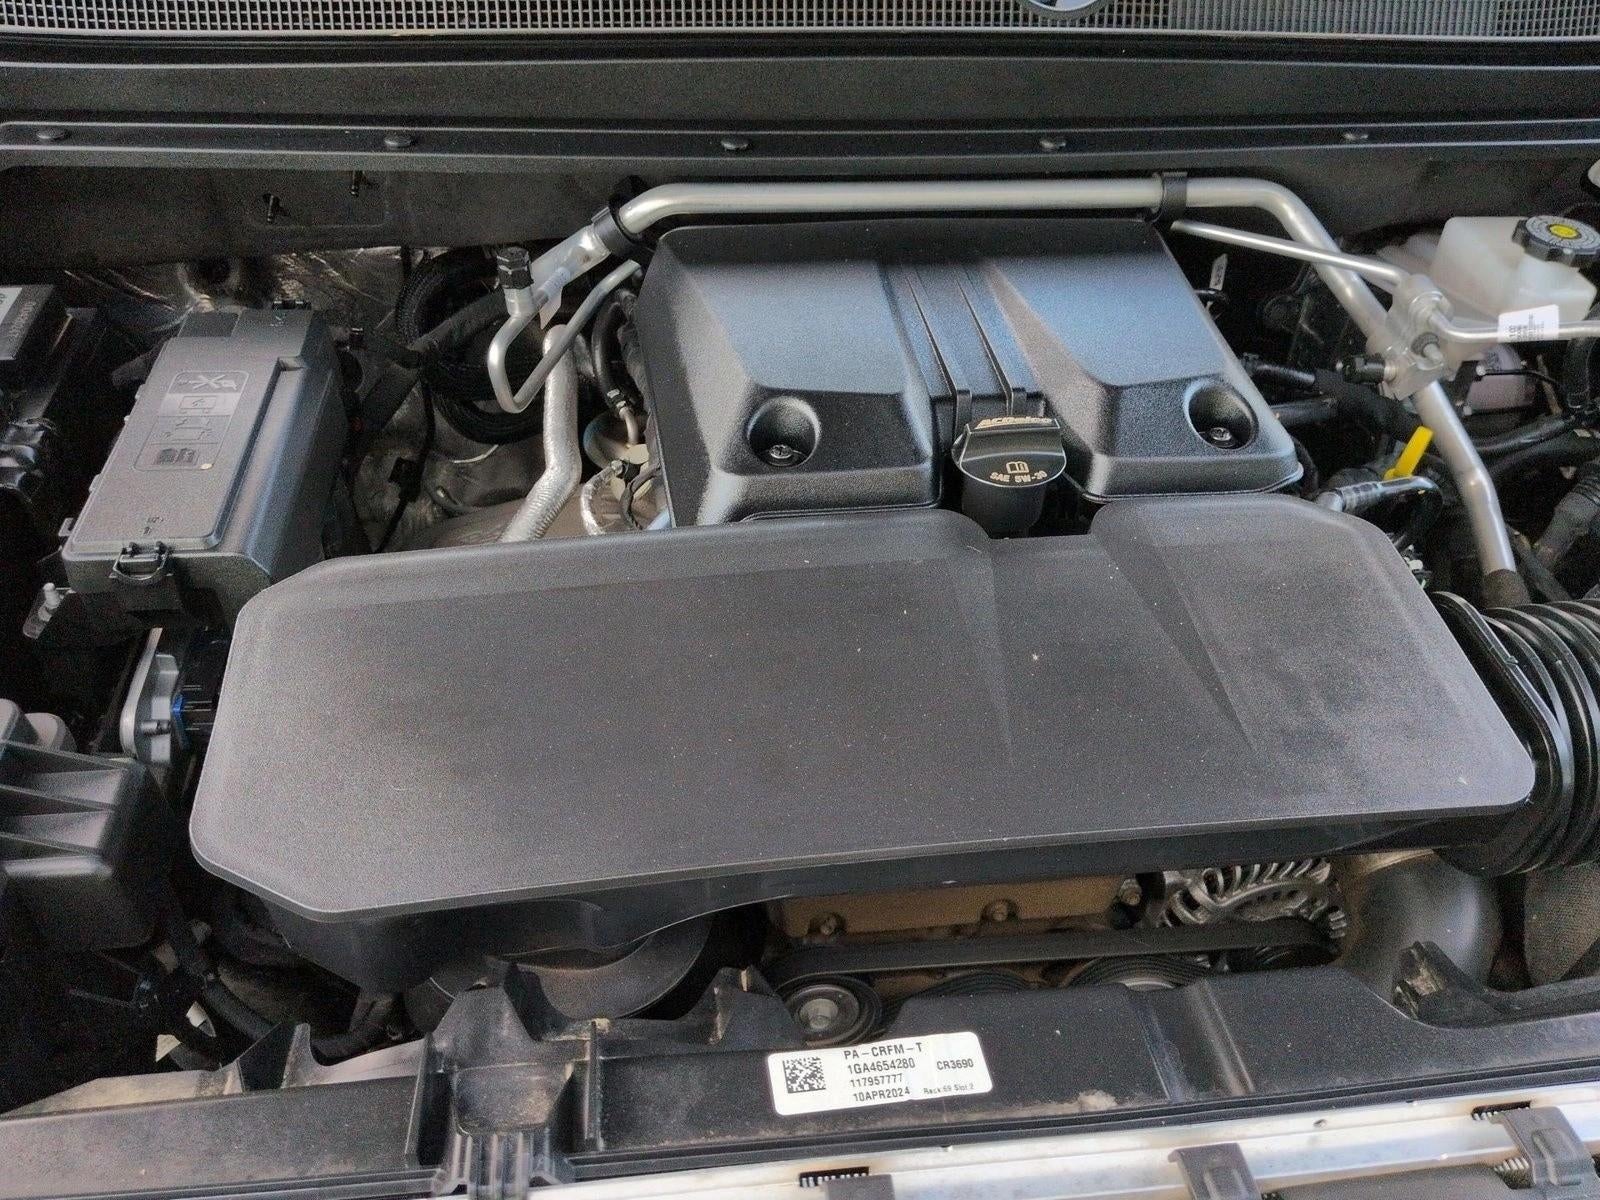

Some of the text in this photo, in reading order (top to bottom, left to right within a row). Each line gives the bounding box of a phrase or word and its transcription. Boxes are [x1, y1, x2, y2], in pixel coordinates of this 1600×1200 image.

[990, 472, 1010, 482] SAE
[848, 1058, 916, 1074] 1GA4654280
[936, 1058, 974, 1070] CR3690
[850, 1073, 902, 1087] 117957777
[853, 1086, 910, 1101] 10APR2024
